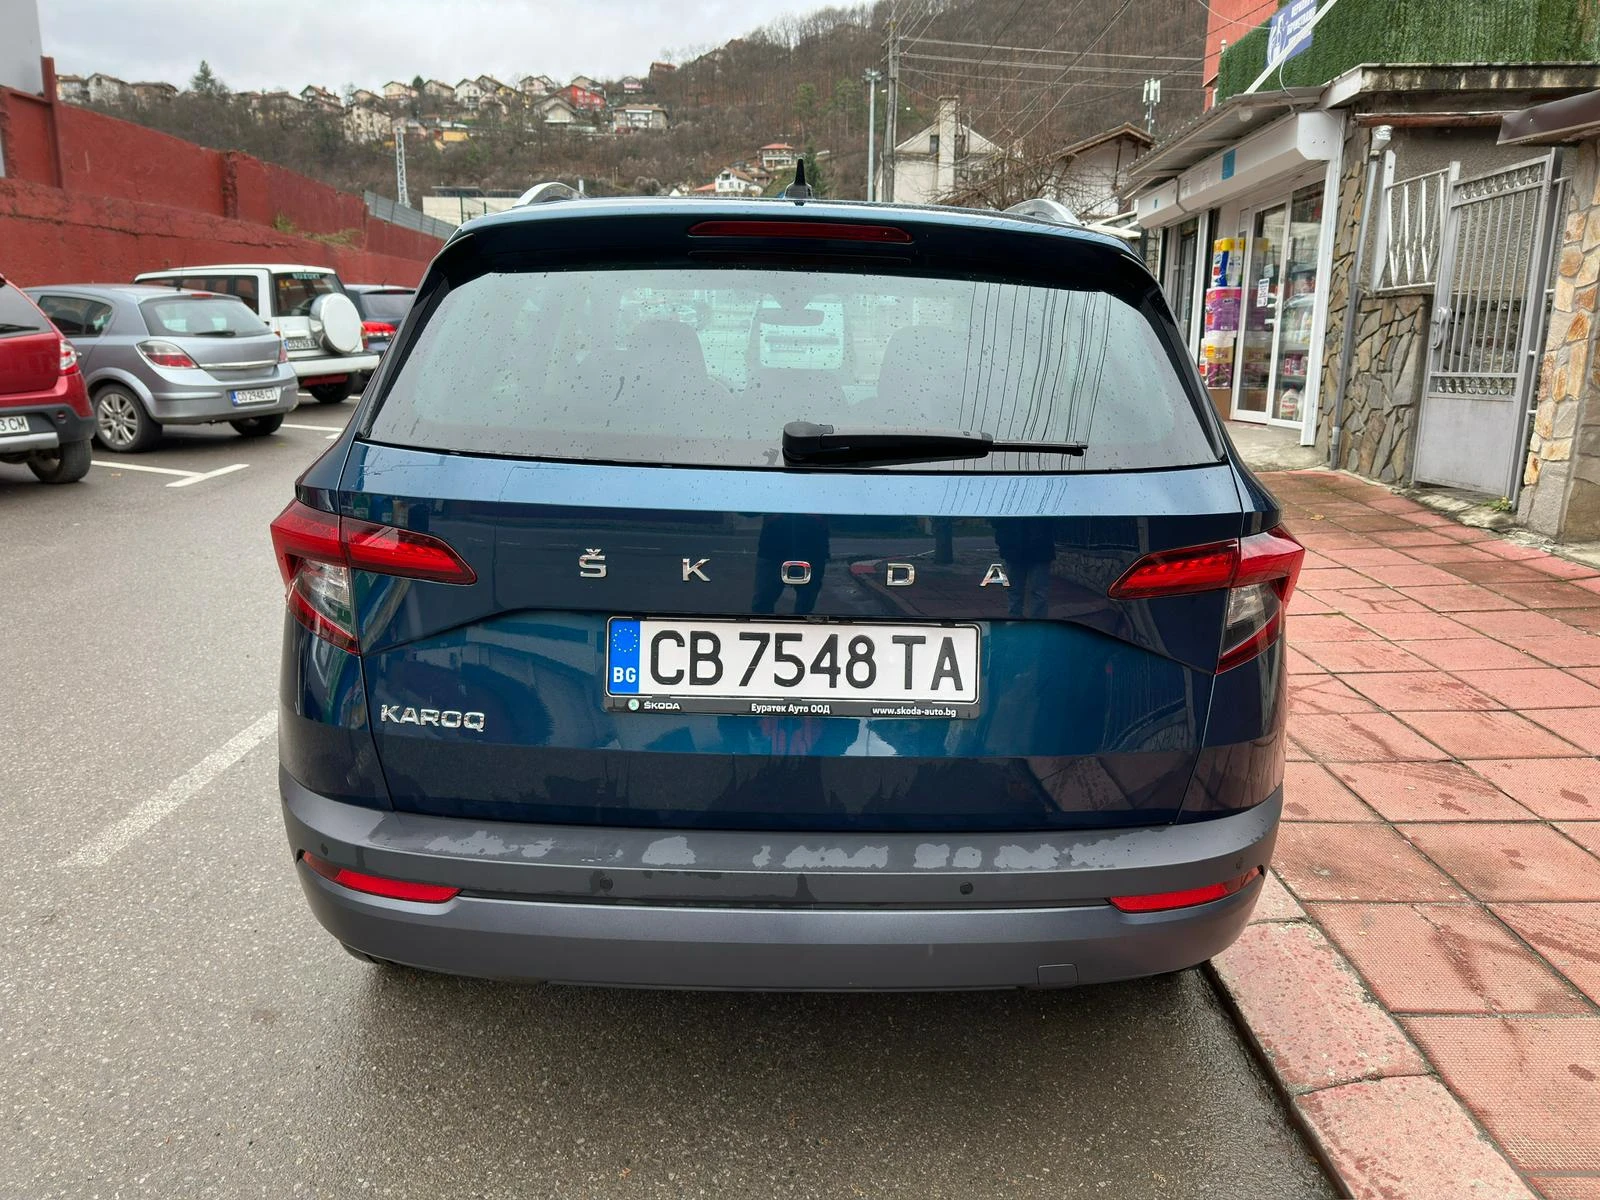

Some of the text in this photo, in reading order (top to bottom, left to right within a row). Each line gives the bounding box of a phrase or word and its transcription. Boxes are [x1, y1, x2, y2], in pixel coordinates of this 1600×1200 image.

[9, 417, 27, 431] CM
[578, 548, 1010, 588] ŠKODA
[650, 629, 964, 691] CB 7548 TA
[613, 667, 637, 683] BG
[643, 701, 681, 710] ŠKODA
[751, 703, 831, 714] Еуратек Ауто ООД
[872, 706, 957, 718] www.skoda-auto.bg
[380, 704, 485, 732] KAROQ
